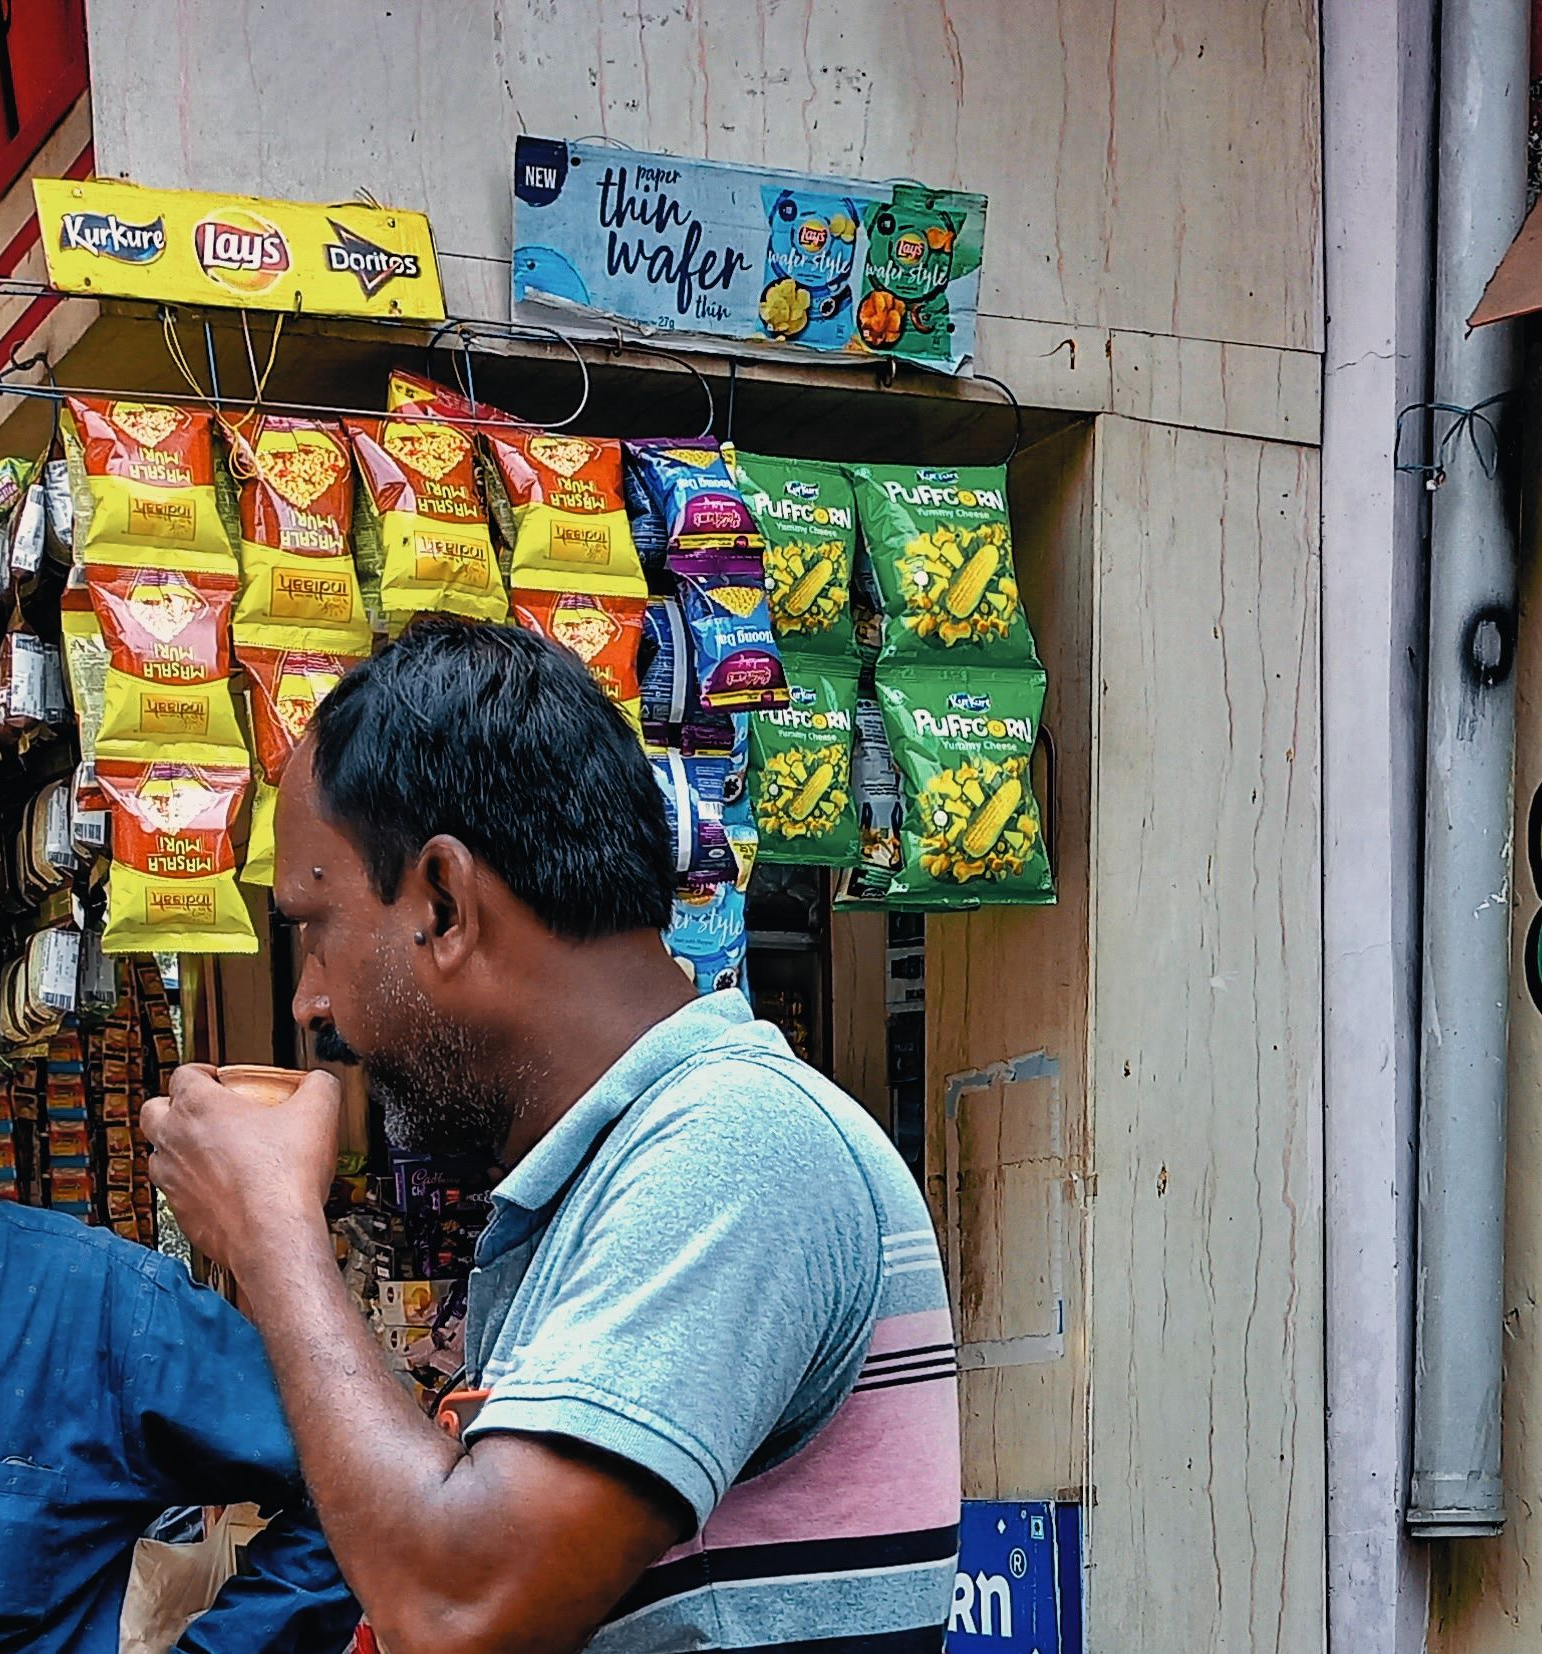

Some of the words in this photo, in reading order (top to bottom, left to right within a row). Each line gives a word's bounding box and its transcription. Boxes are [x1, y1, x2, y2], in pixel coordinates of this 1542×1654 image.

[525, 165, 557, 190] NEW
[636, 165, 681, 192] paper
[596, 167, 692, 233] thin
[62, 213, 165, 257] Kurkure
[203, 223, 281, 270] Lay's
[800, 227, 828, 244] Lay's
[330, 246, 418, 275] Doritos
[898, 241, 925, 257] Lay's
[607, 220, 752, 315] wafer
[768, 249, 807, 272] wafer
[811, 252, 851, 278] style
[865, 262, 903, 286] wafer
[907, 264, 948, 291] style
[695, 295, 731, 320] thin
[130, 463, 191, 484] MASALA
[418, 497, 478, 518] MASALA
[550, 492, 605, 510] MASALA
[883, 481, 1004, 511] PUFFCORN
[754, 492, 852, 529] PUFFCORN
[280, 529, 343, 550] MASALA
[144, 661, 207, 680] MASALA
[913, 709, 1032, 743] PUFFCORN
[148, 855, 213, 872] MASALA
